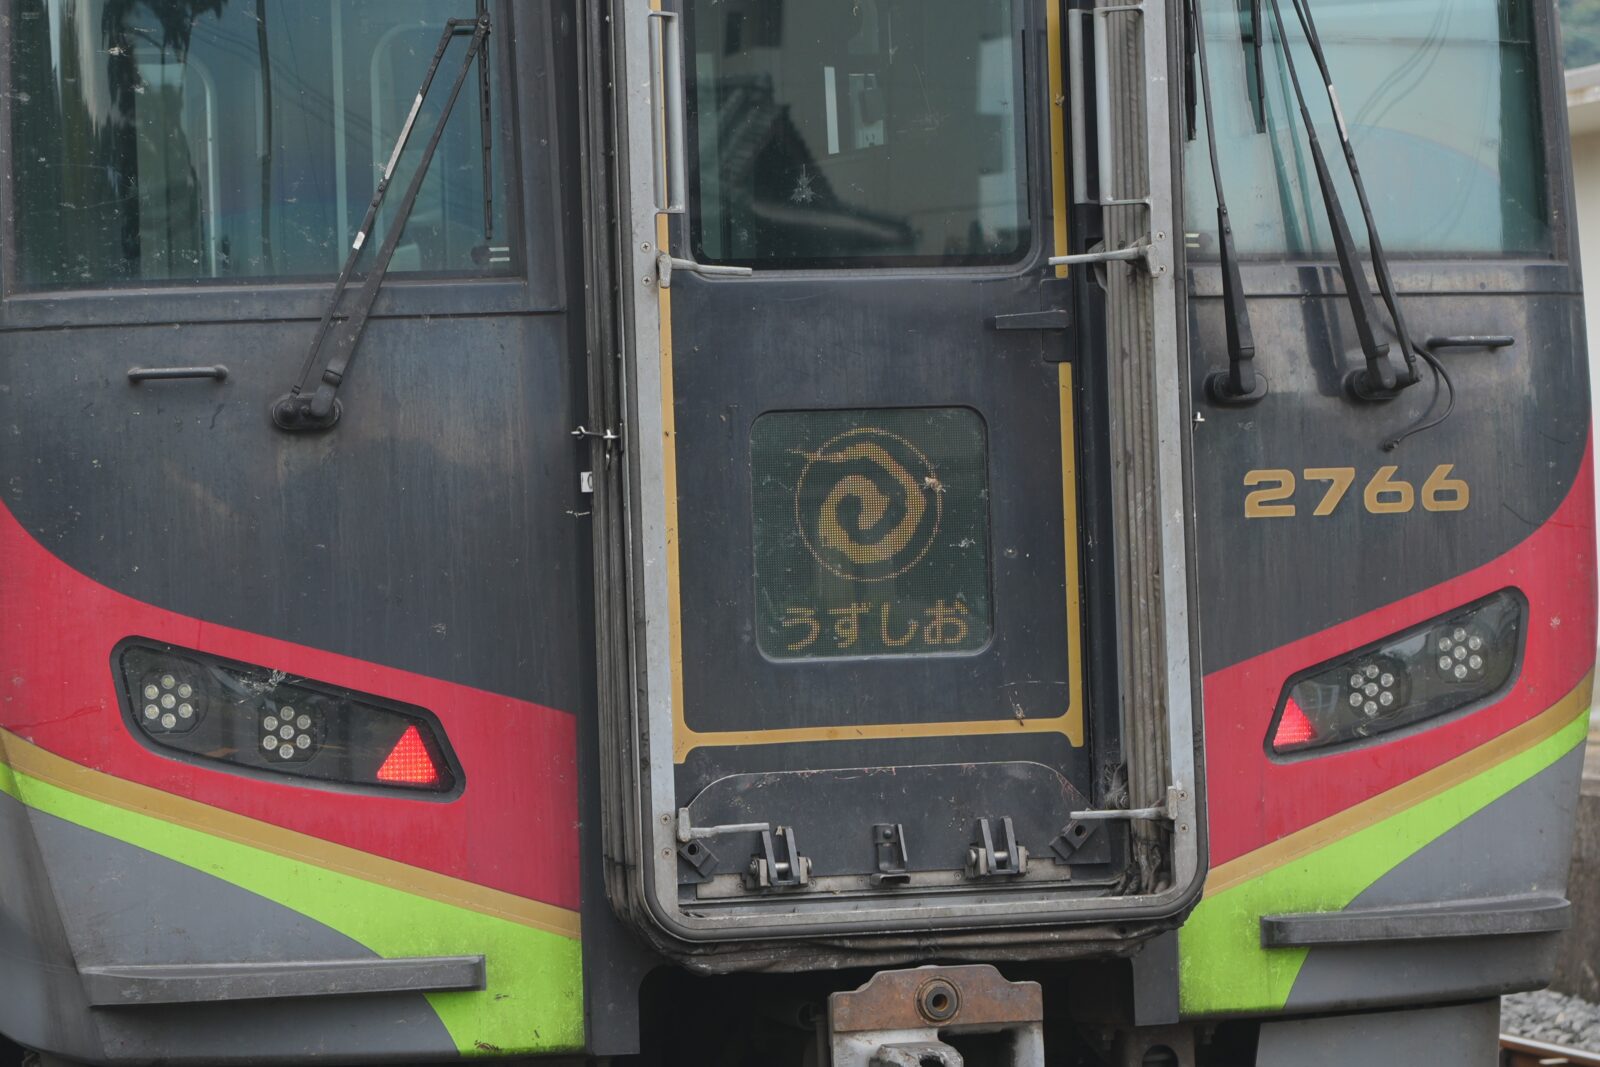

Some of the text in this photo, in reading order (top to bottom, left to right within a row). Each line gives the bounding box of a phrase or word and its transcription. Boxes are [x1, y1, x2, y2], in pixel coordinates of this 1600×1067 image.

[1243, 464, 1470, 518] 2766
[782, 599, 969, 651] うずしお
